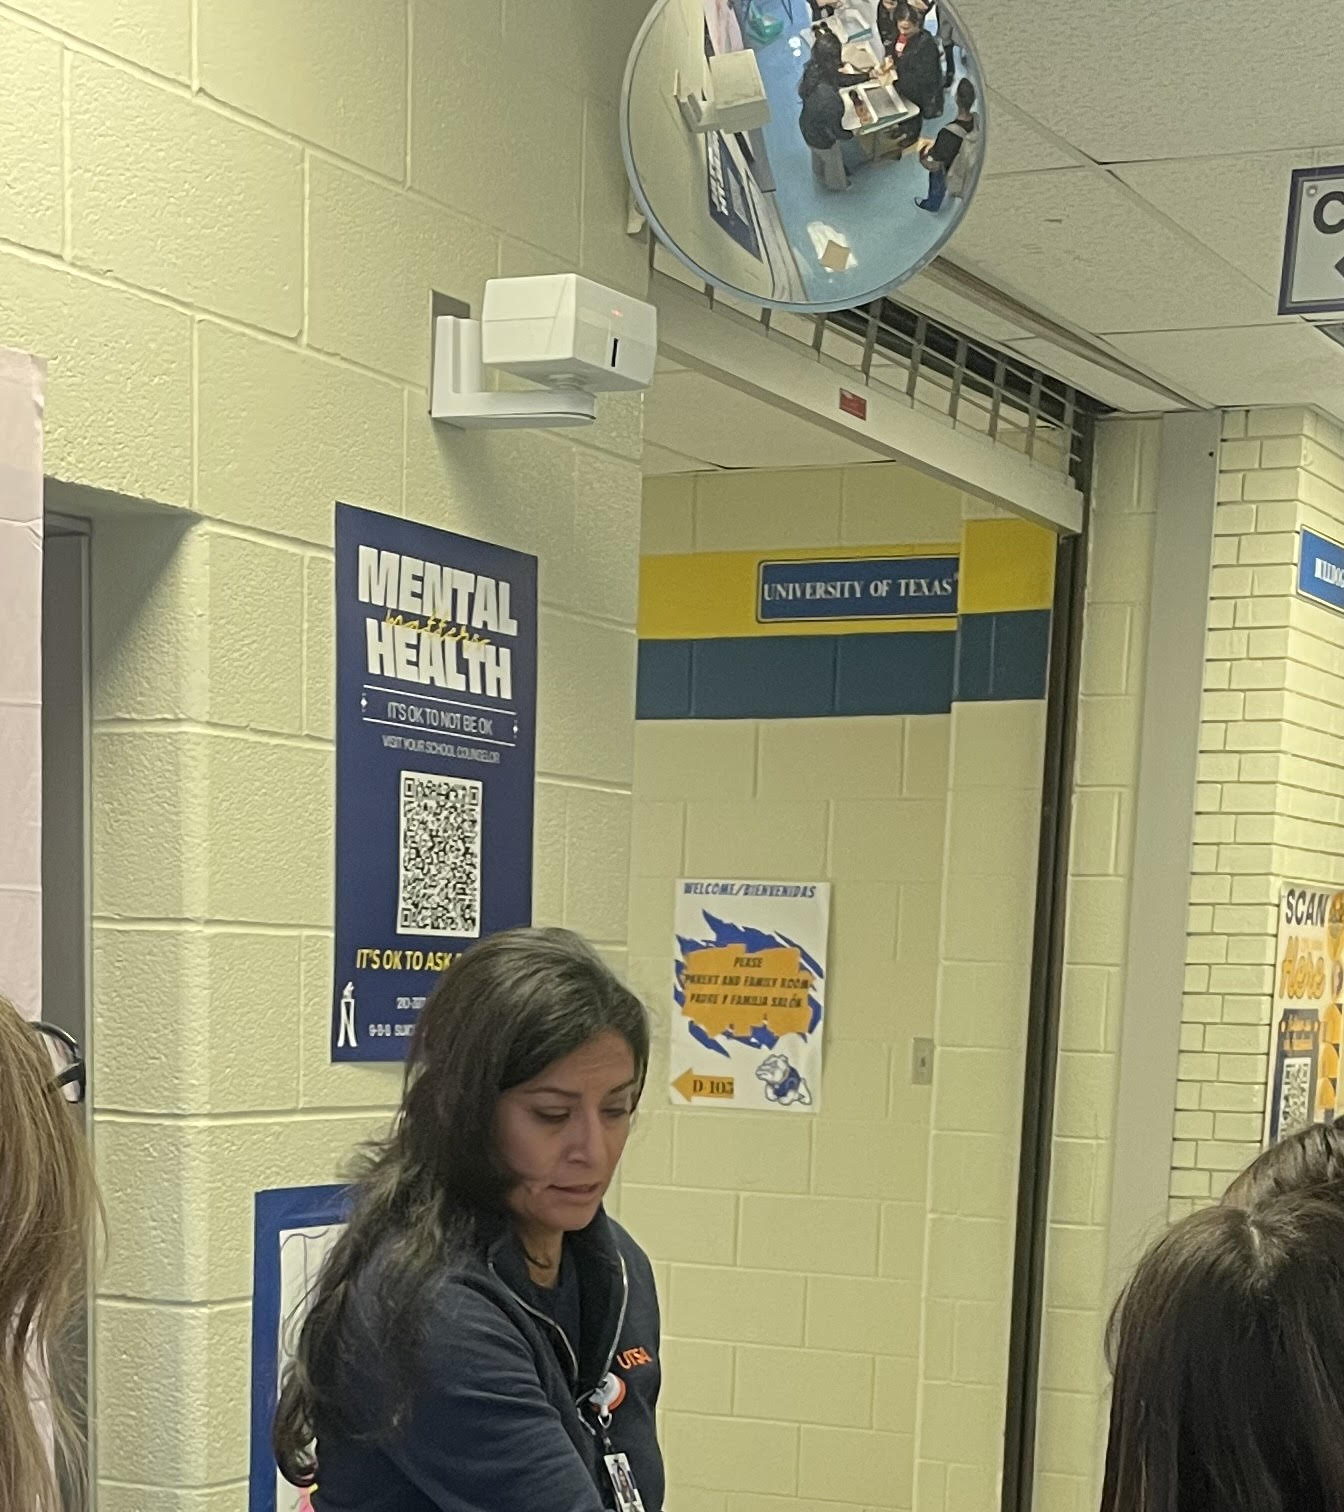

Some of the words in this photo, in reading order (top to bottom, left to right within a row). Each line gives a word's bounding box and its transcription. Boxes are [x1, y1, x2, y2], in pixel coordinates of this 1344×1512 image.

[358, 544, 518, 636] MENTAL
[764, 580, 863, 600] UNIVERSITY
[869, 580, 892, 596] OF
[897, 578, 952, 596] TEXAS
[366, 617, 512, 700] HEALTH
[407, 706, 424, 724] OK
[424, 709, 439, 726] TO
[441, 712, 462, 730] NOT
[463, 716, 478, 732] BE
[478, 718, 493, 735] OK
[425, 741, 456, 757] SCHOOL
[1286, 888, 1329, 927] SCAN
[356, 948, 381, 969] IT'S
[382, 949, 402, 970] OK
[405, 951, 423, 971] TO
[424, 951, 452, 972] ASK
[721, 975, 740, 986] AND
[744, 976, 778, 988] FAMILY
[692, 1079, 703, 1093] D
